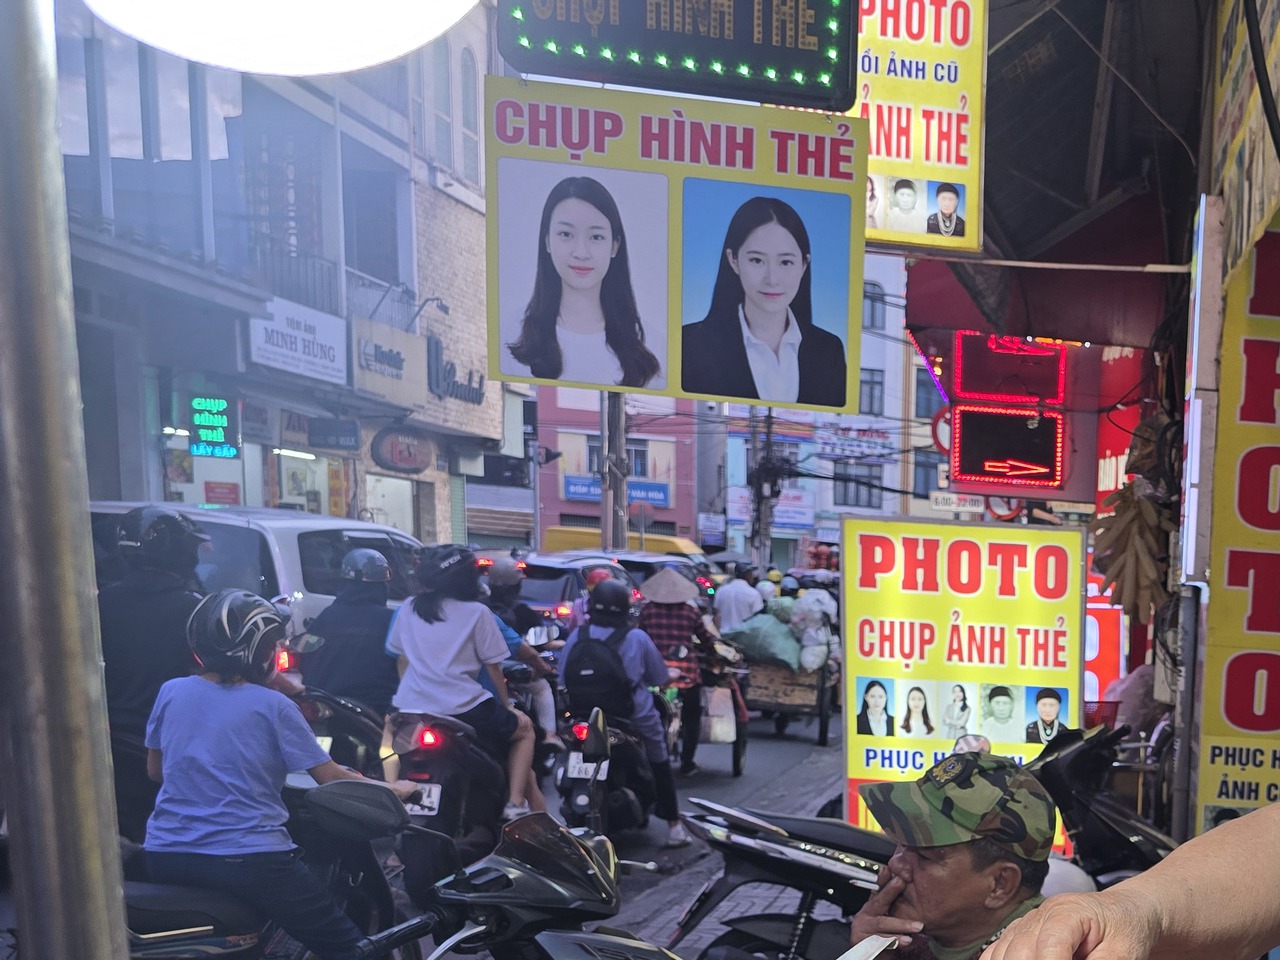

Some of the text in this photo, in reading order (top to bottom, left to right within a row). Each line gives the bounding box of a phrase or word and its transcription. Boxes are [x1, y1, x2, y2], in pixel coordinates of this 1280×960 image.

[859, 0, 970, 46] PHOTO
[887, 51, 926, 80] ẢNH
[934, 61, 958, 83] CŨ
[496, 100, 854, 181] CHỤP HÌNH THẺ
[922, 95, 969, 166] THẺ
[264, 326, 298, 353] MINH
[302, 336, 336, 363] HÙNG
[858, 534, 1069, 599] PHOTO
[859, 611, 1067, 669] CHỤP ẢNH THẺ
[865, 748, 924, 774] PHỤC
[1210, 745, 1265, 771] PHỤC
[1217, 773, 1259, 801] ẢNH
